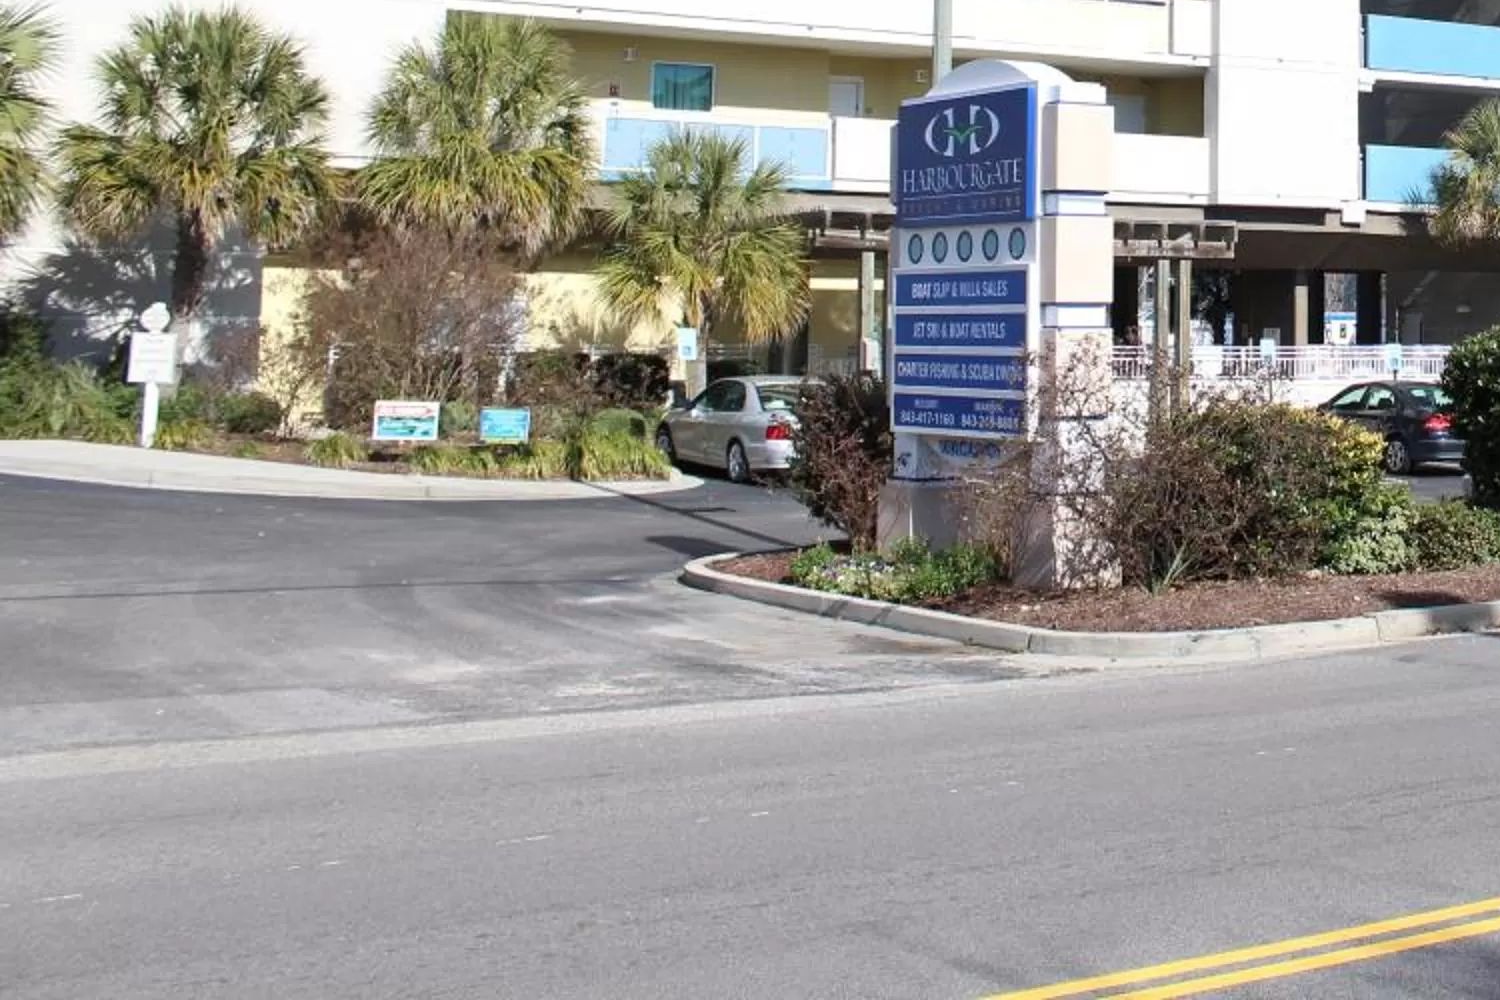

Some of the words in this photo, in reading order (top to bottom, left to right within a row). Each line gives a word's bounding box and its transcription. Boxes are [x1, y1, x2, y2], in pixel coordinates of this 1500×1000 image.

[902, 158, 1023, 194] HARBOURGATE
[911, 282, 931, 299] BOAT
[982, 279, 1009, 297] SALES
